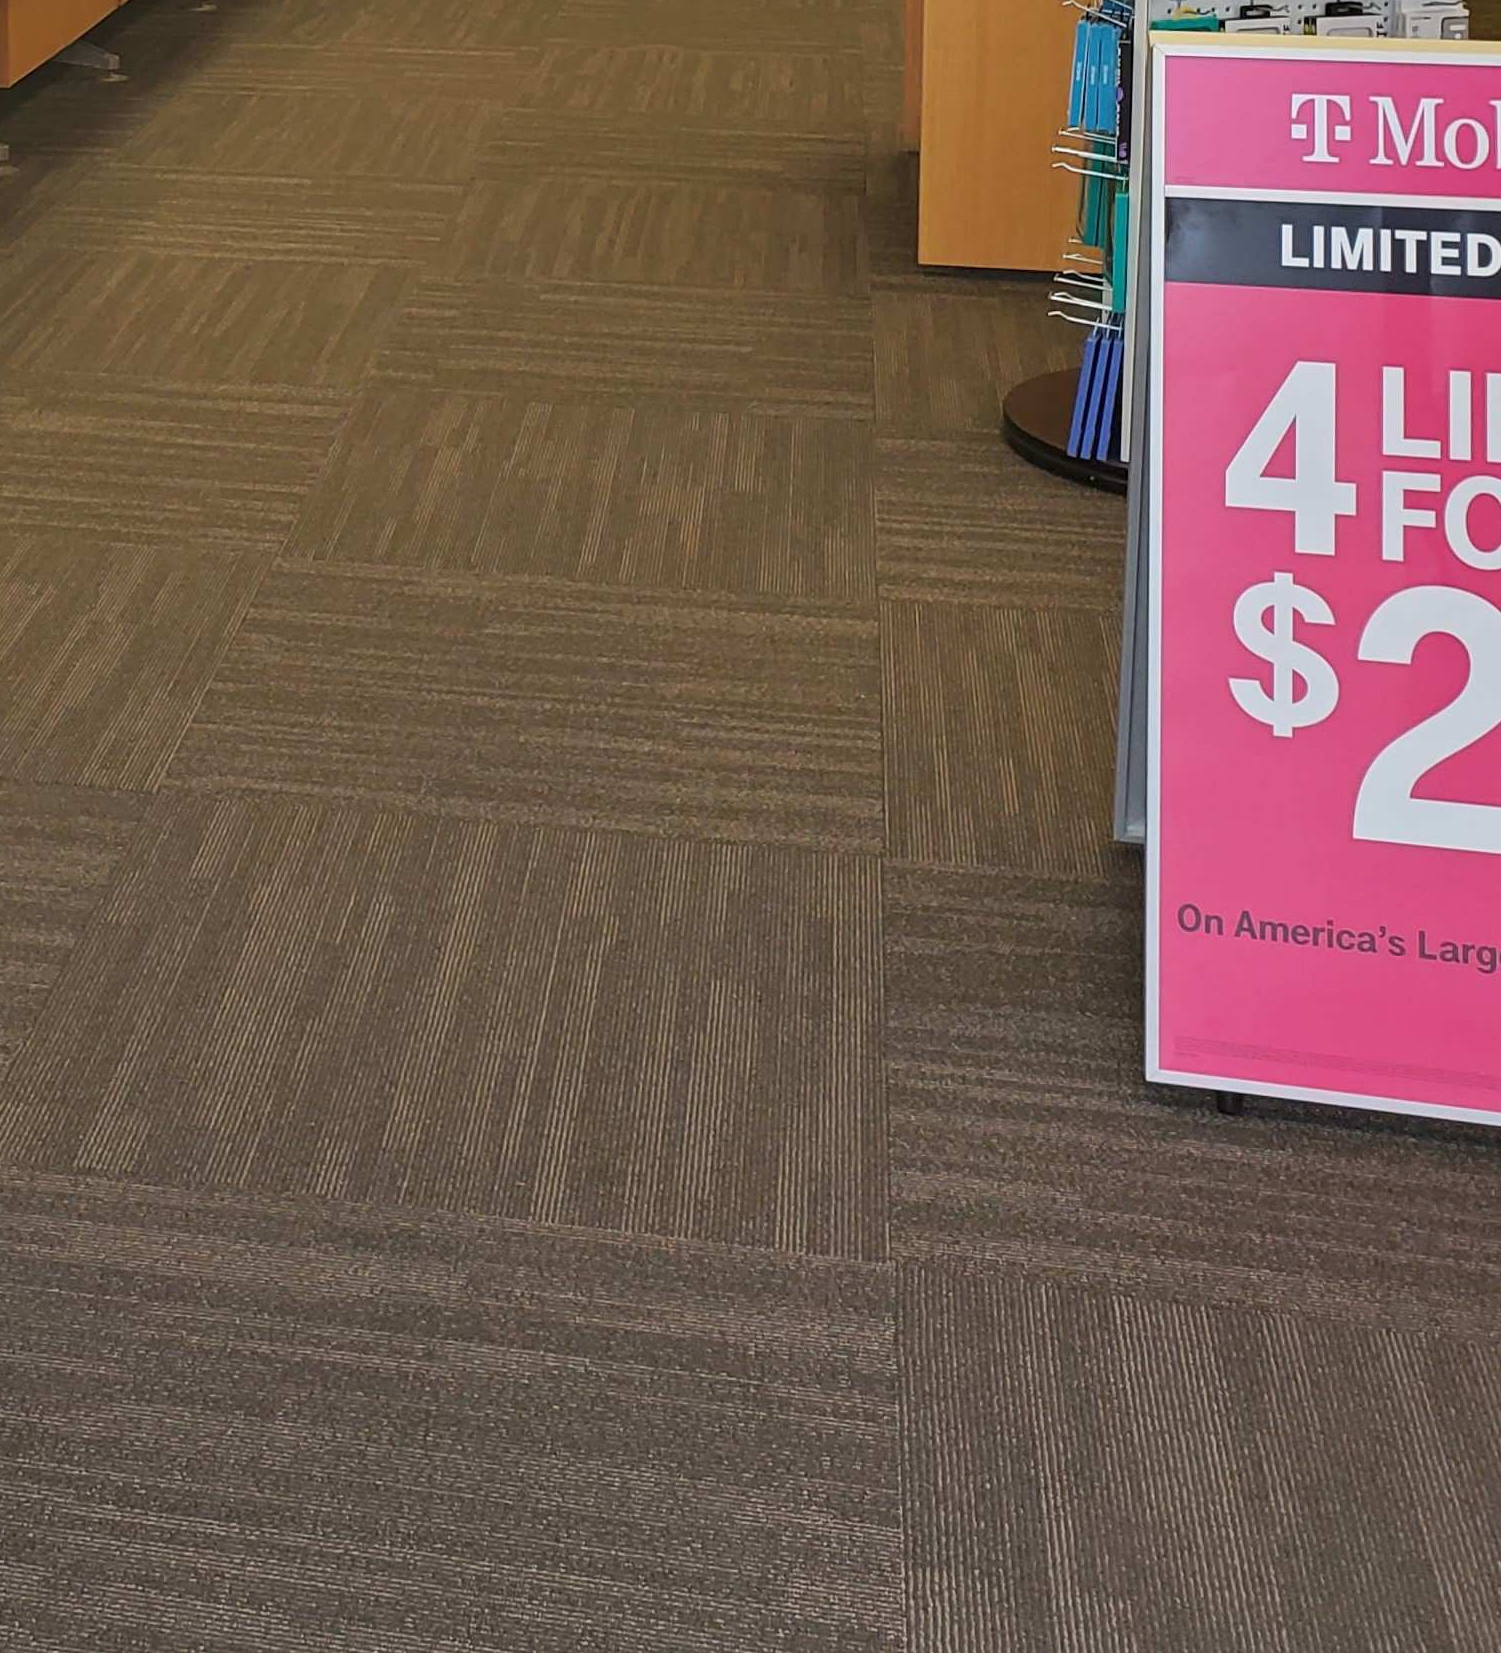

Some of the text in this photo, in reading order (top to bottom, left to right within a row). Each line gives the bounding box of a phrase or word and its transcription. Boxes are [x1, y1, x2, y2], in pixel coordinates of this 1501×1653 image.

[1369, 96, 1501, 170] Mo
[1282, 224, 1501, 278] LIMITED
[1382, 366, 1501, 464] LI
[1225, 361, 1357, 557] 4
[1177, 903, 1501, 975] On America's Larg
